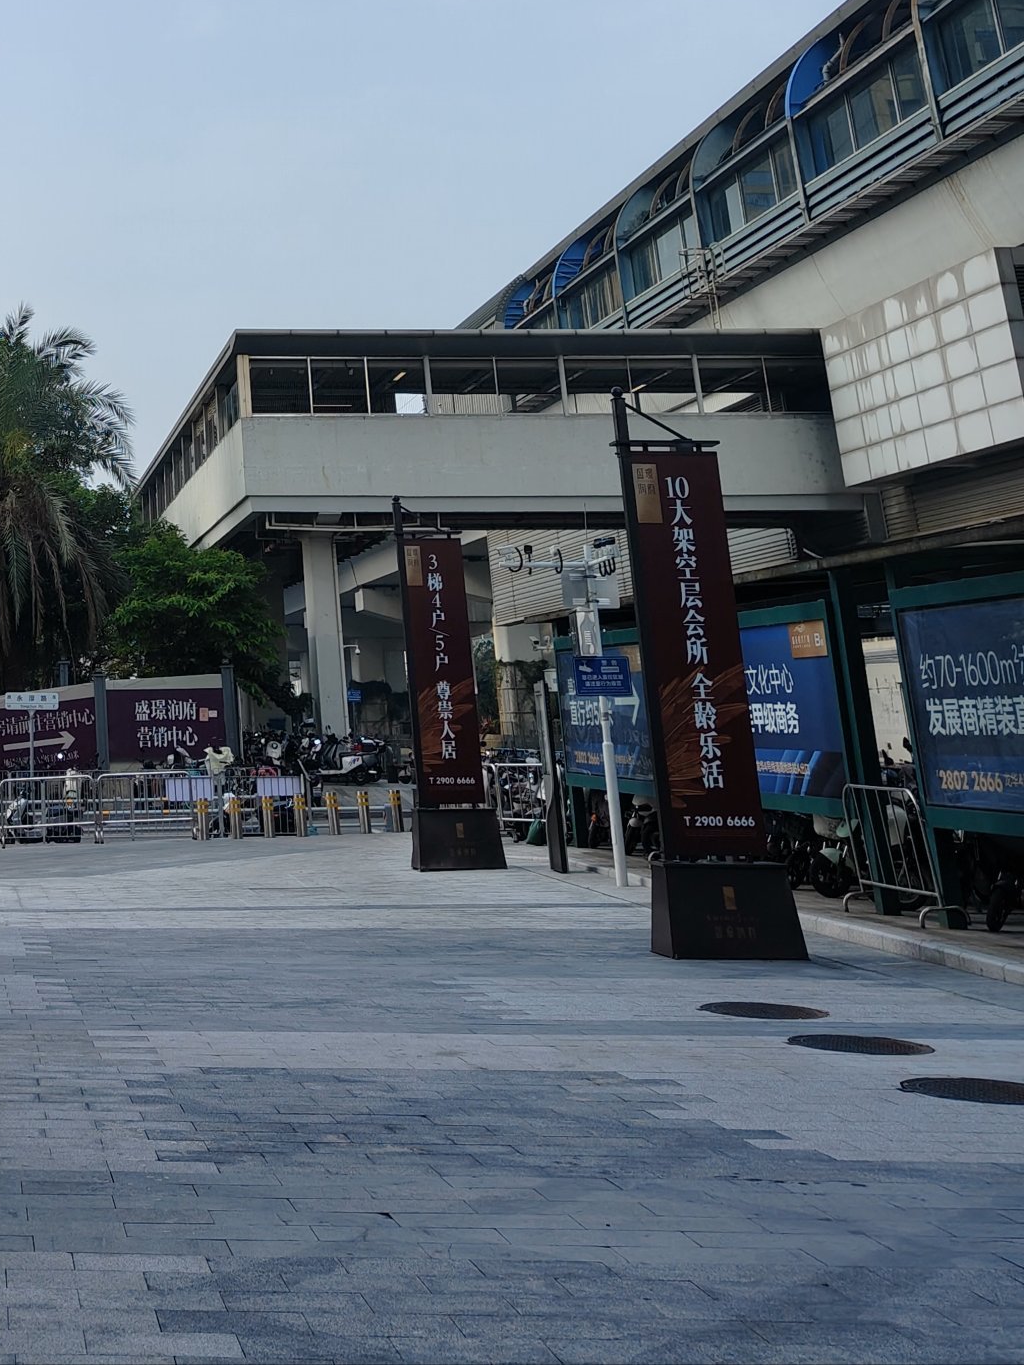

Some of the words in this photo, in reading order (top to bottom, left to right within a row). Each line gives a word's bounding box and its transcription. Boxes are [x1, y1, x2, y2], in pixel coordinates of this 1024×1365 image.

[666, 475, 708, 665] 10大架空层会所
[691, 672, 725, 789] 全龄乐活
[744, 663, 794, 695] 文化中心
[135, 698, 197, 721] 盛璟润府
[436, 681, 457, 760] 尊崇人居
[137, 725, 198, 748] 营销中心
[436, 777, 455, 785] 2900
[939, 769, 969, 791] 2802
[971, 770, 1004, 793] 2666
[683, 816, 692, 827] T
[694, 815, 724, 828] 2900
[726, 815, 755, 827] 6666
